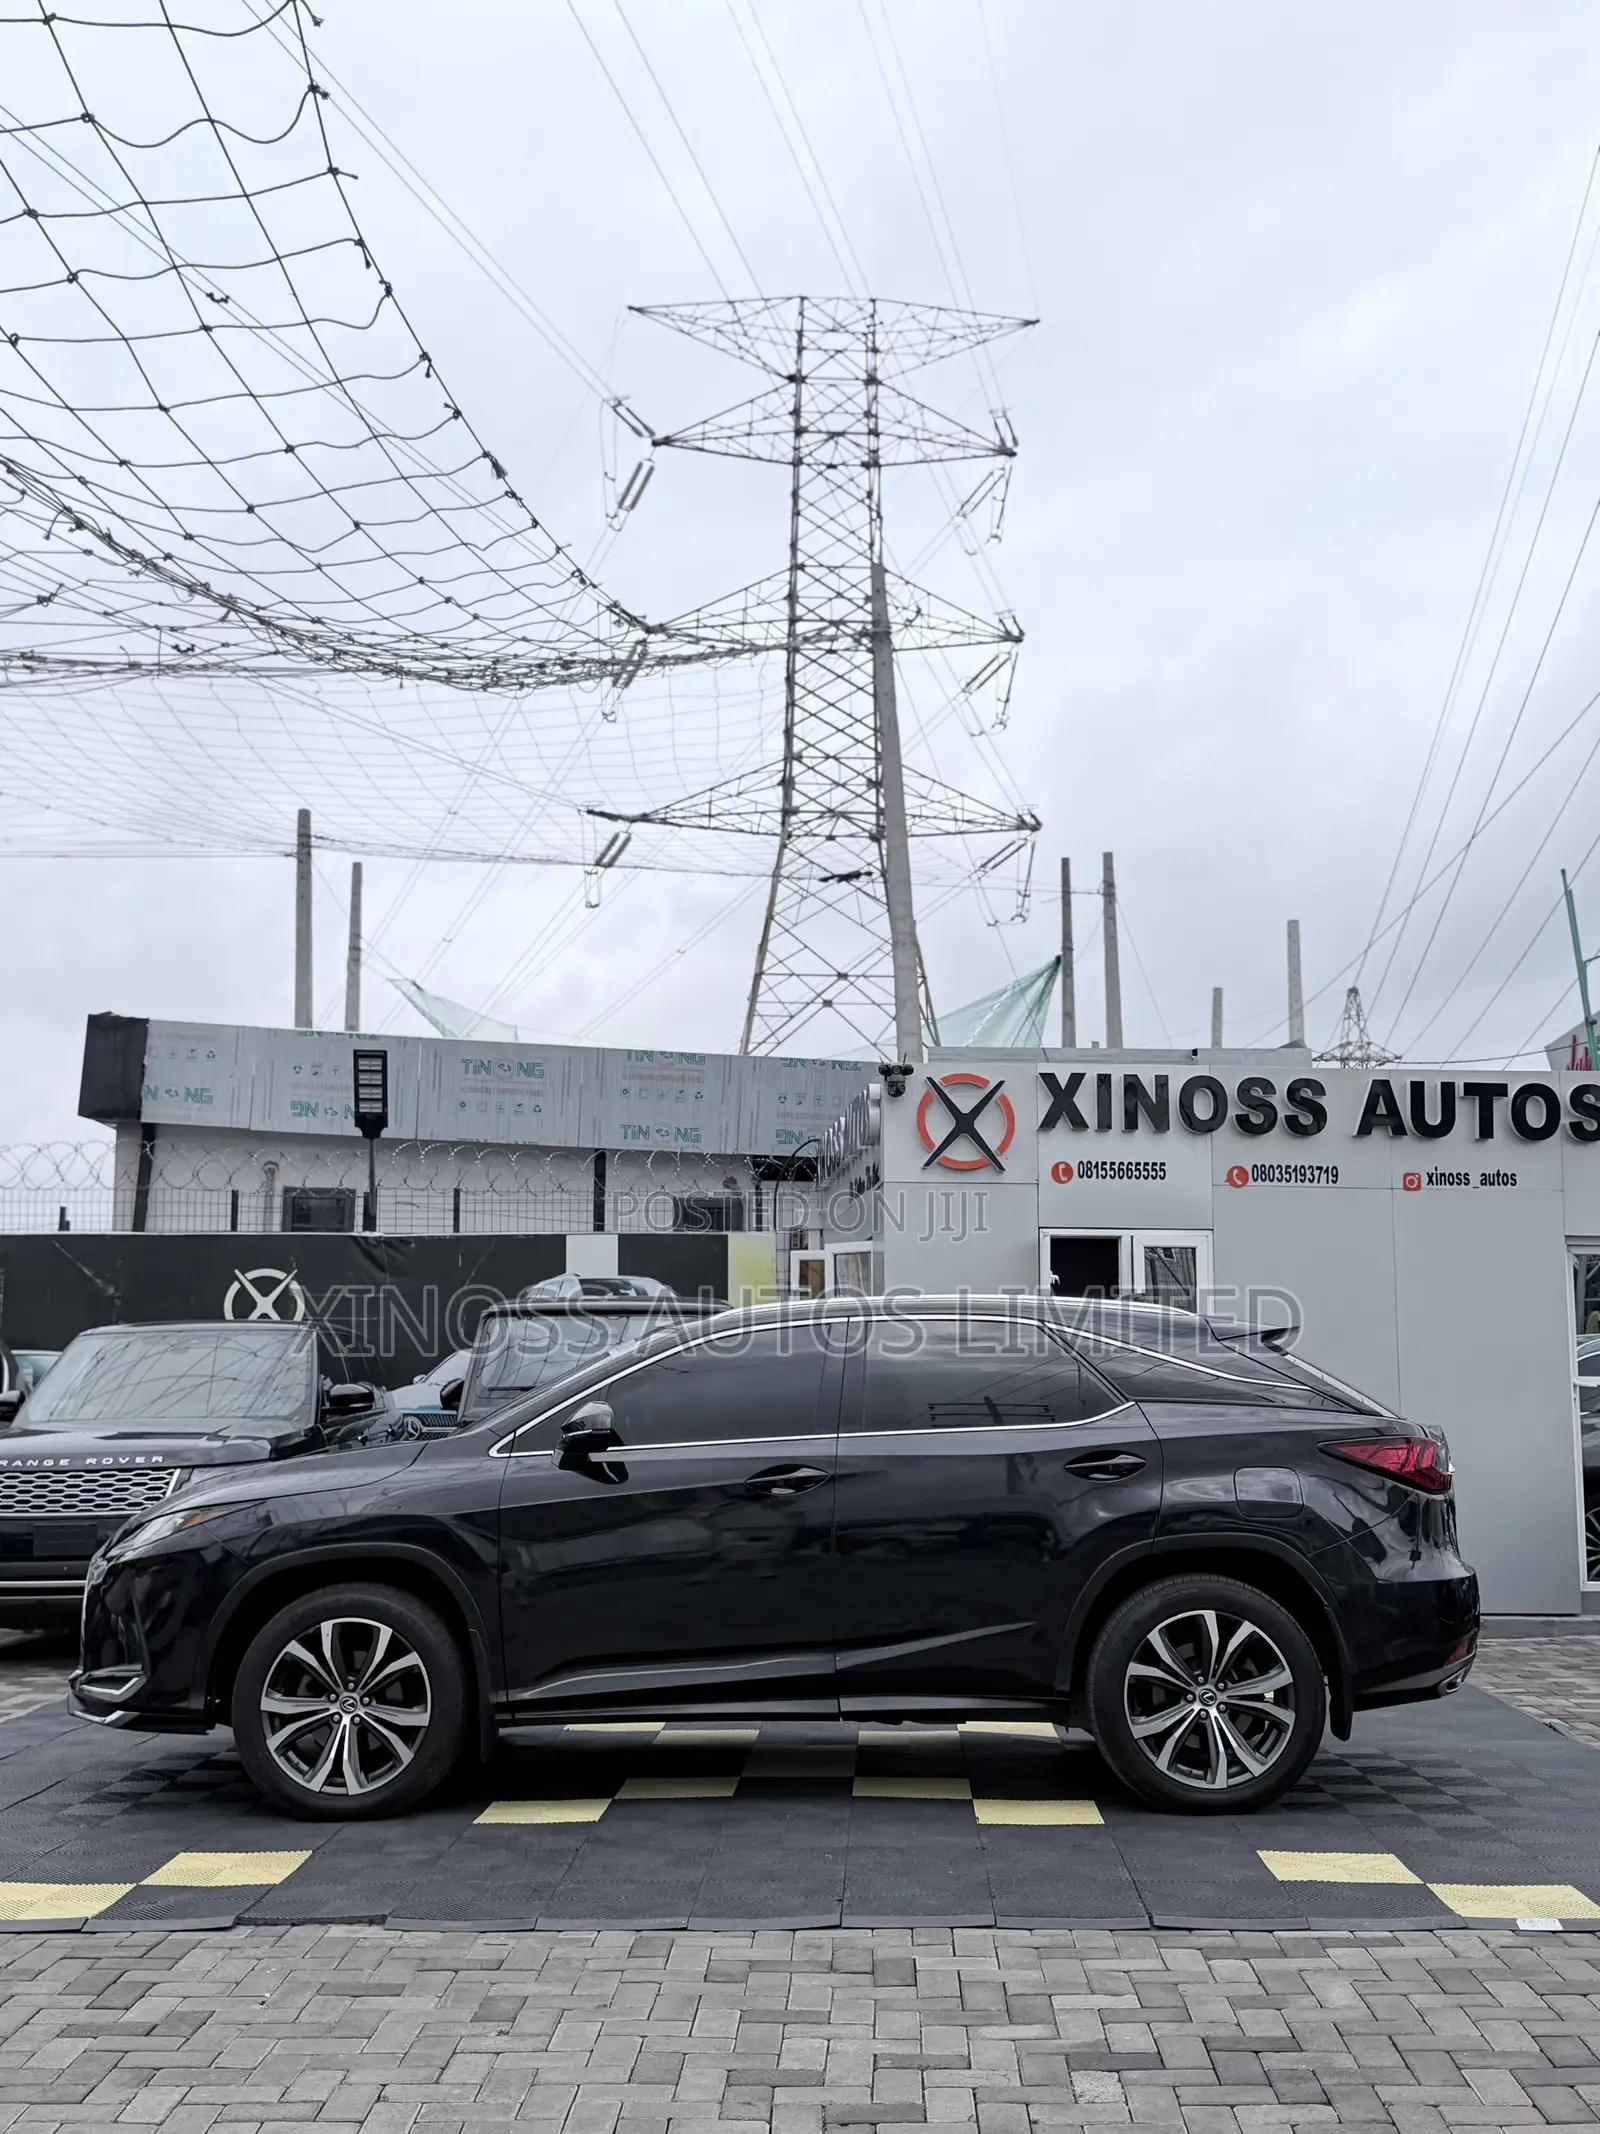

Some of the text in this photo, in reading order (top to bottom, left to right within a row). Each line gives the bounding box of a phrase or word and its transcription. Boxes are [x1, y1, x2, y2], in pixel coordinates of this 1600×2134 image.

[1037, 1072, 1600, 1143] XINOSS AUTOS
[1077, 1160, 1167, 1181] 08155665555
[1251, 1163, 1339, 1185] 08035193719
[0, 1455, 164, 1467] RANGE ROVER
